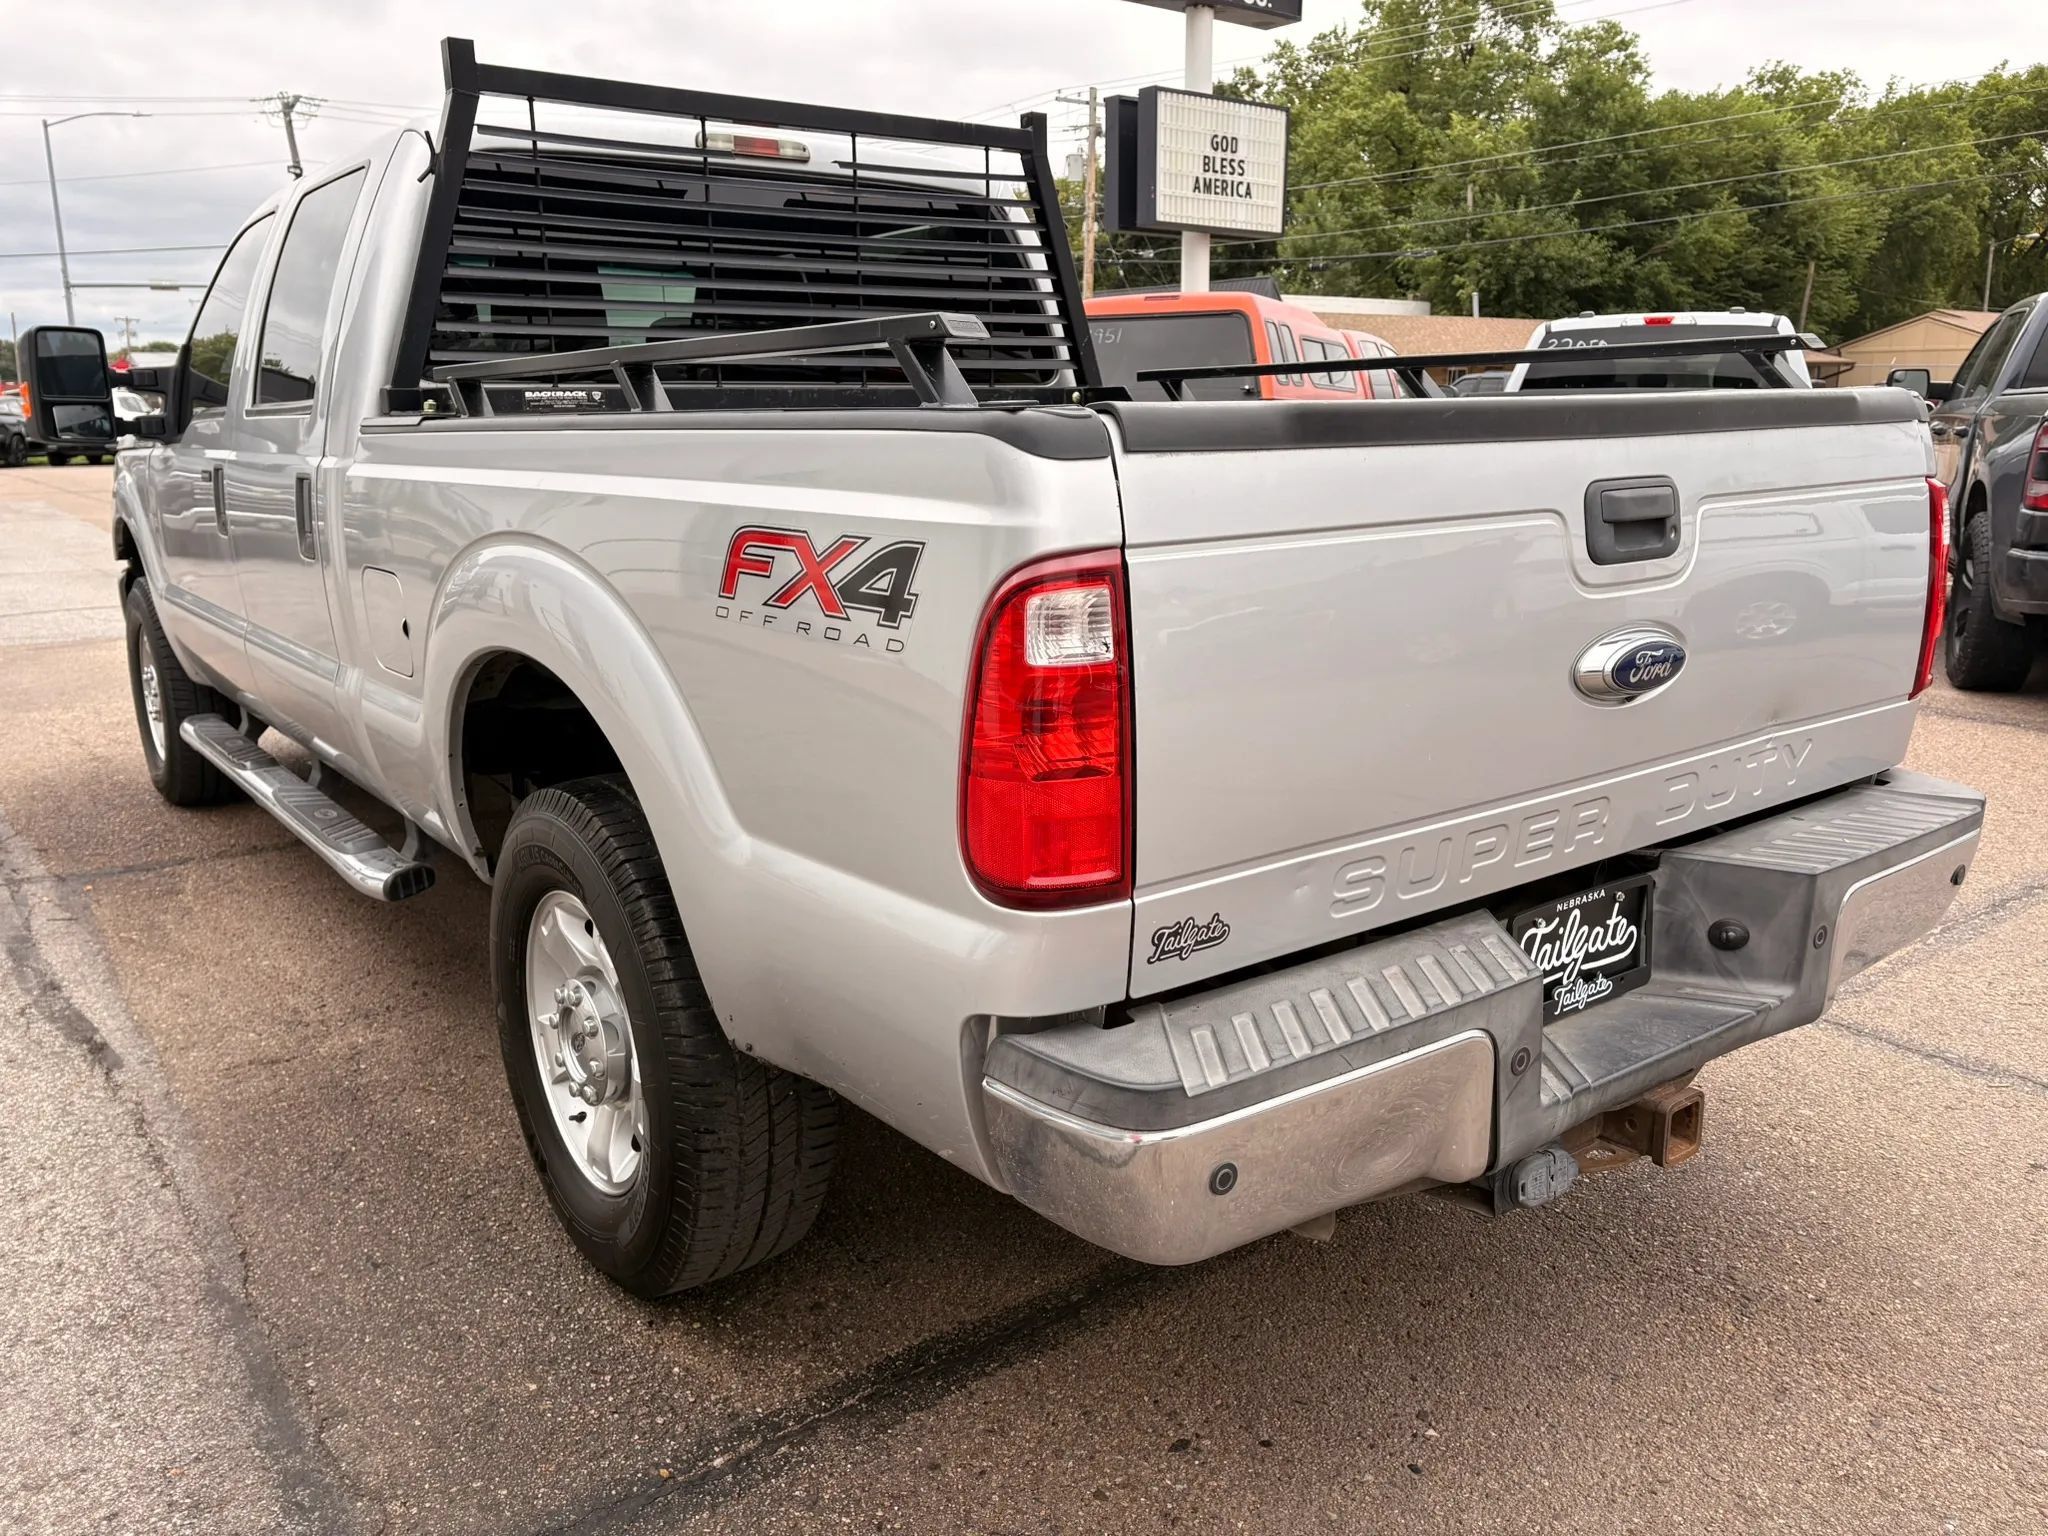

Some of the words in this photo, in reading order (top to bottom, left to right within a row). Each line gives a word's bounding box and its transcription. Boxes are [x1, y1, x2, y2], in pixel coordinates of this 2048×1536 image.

[1211, 134, 1238, 154] GOD
[1203, 155, 1245, 176] BLESS
[1193, 176, 1252, 199] AMERICA
[718, 525, 926, 630] FX4
[715, 605, 777, 627] OFF
[796, 621, 905, 653] ROAD
[1630, 649, 1675, 683] Ford
[1329, 795, 1611, 918] SUPER
[1656, 738, 1813, 826] DUTY
[1556, 889, 1606, 912] NEBRASKA
[1148, 913, 1229, 963] Tailgate
[1520, 902, 1637, 985] Tailgate
[1554, 973, 1613, 1015] Tailgate
